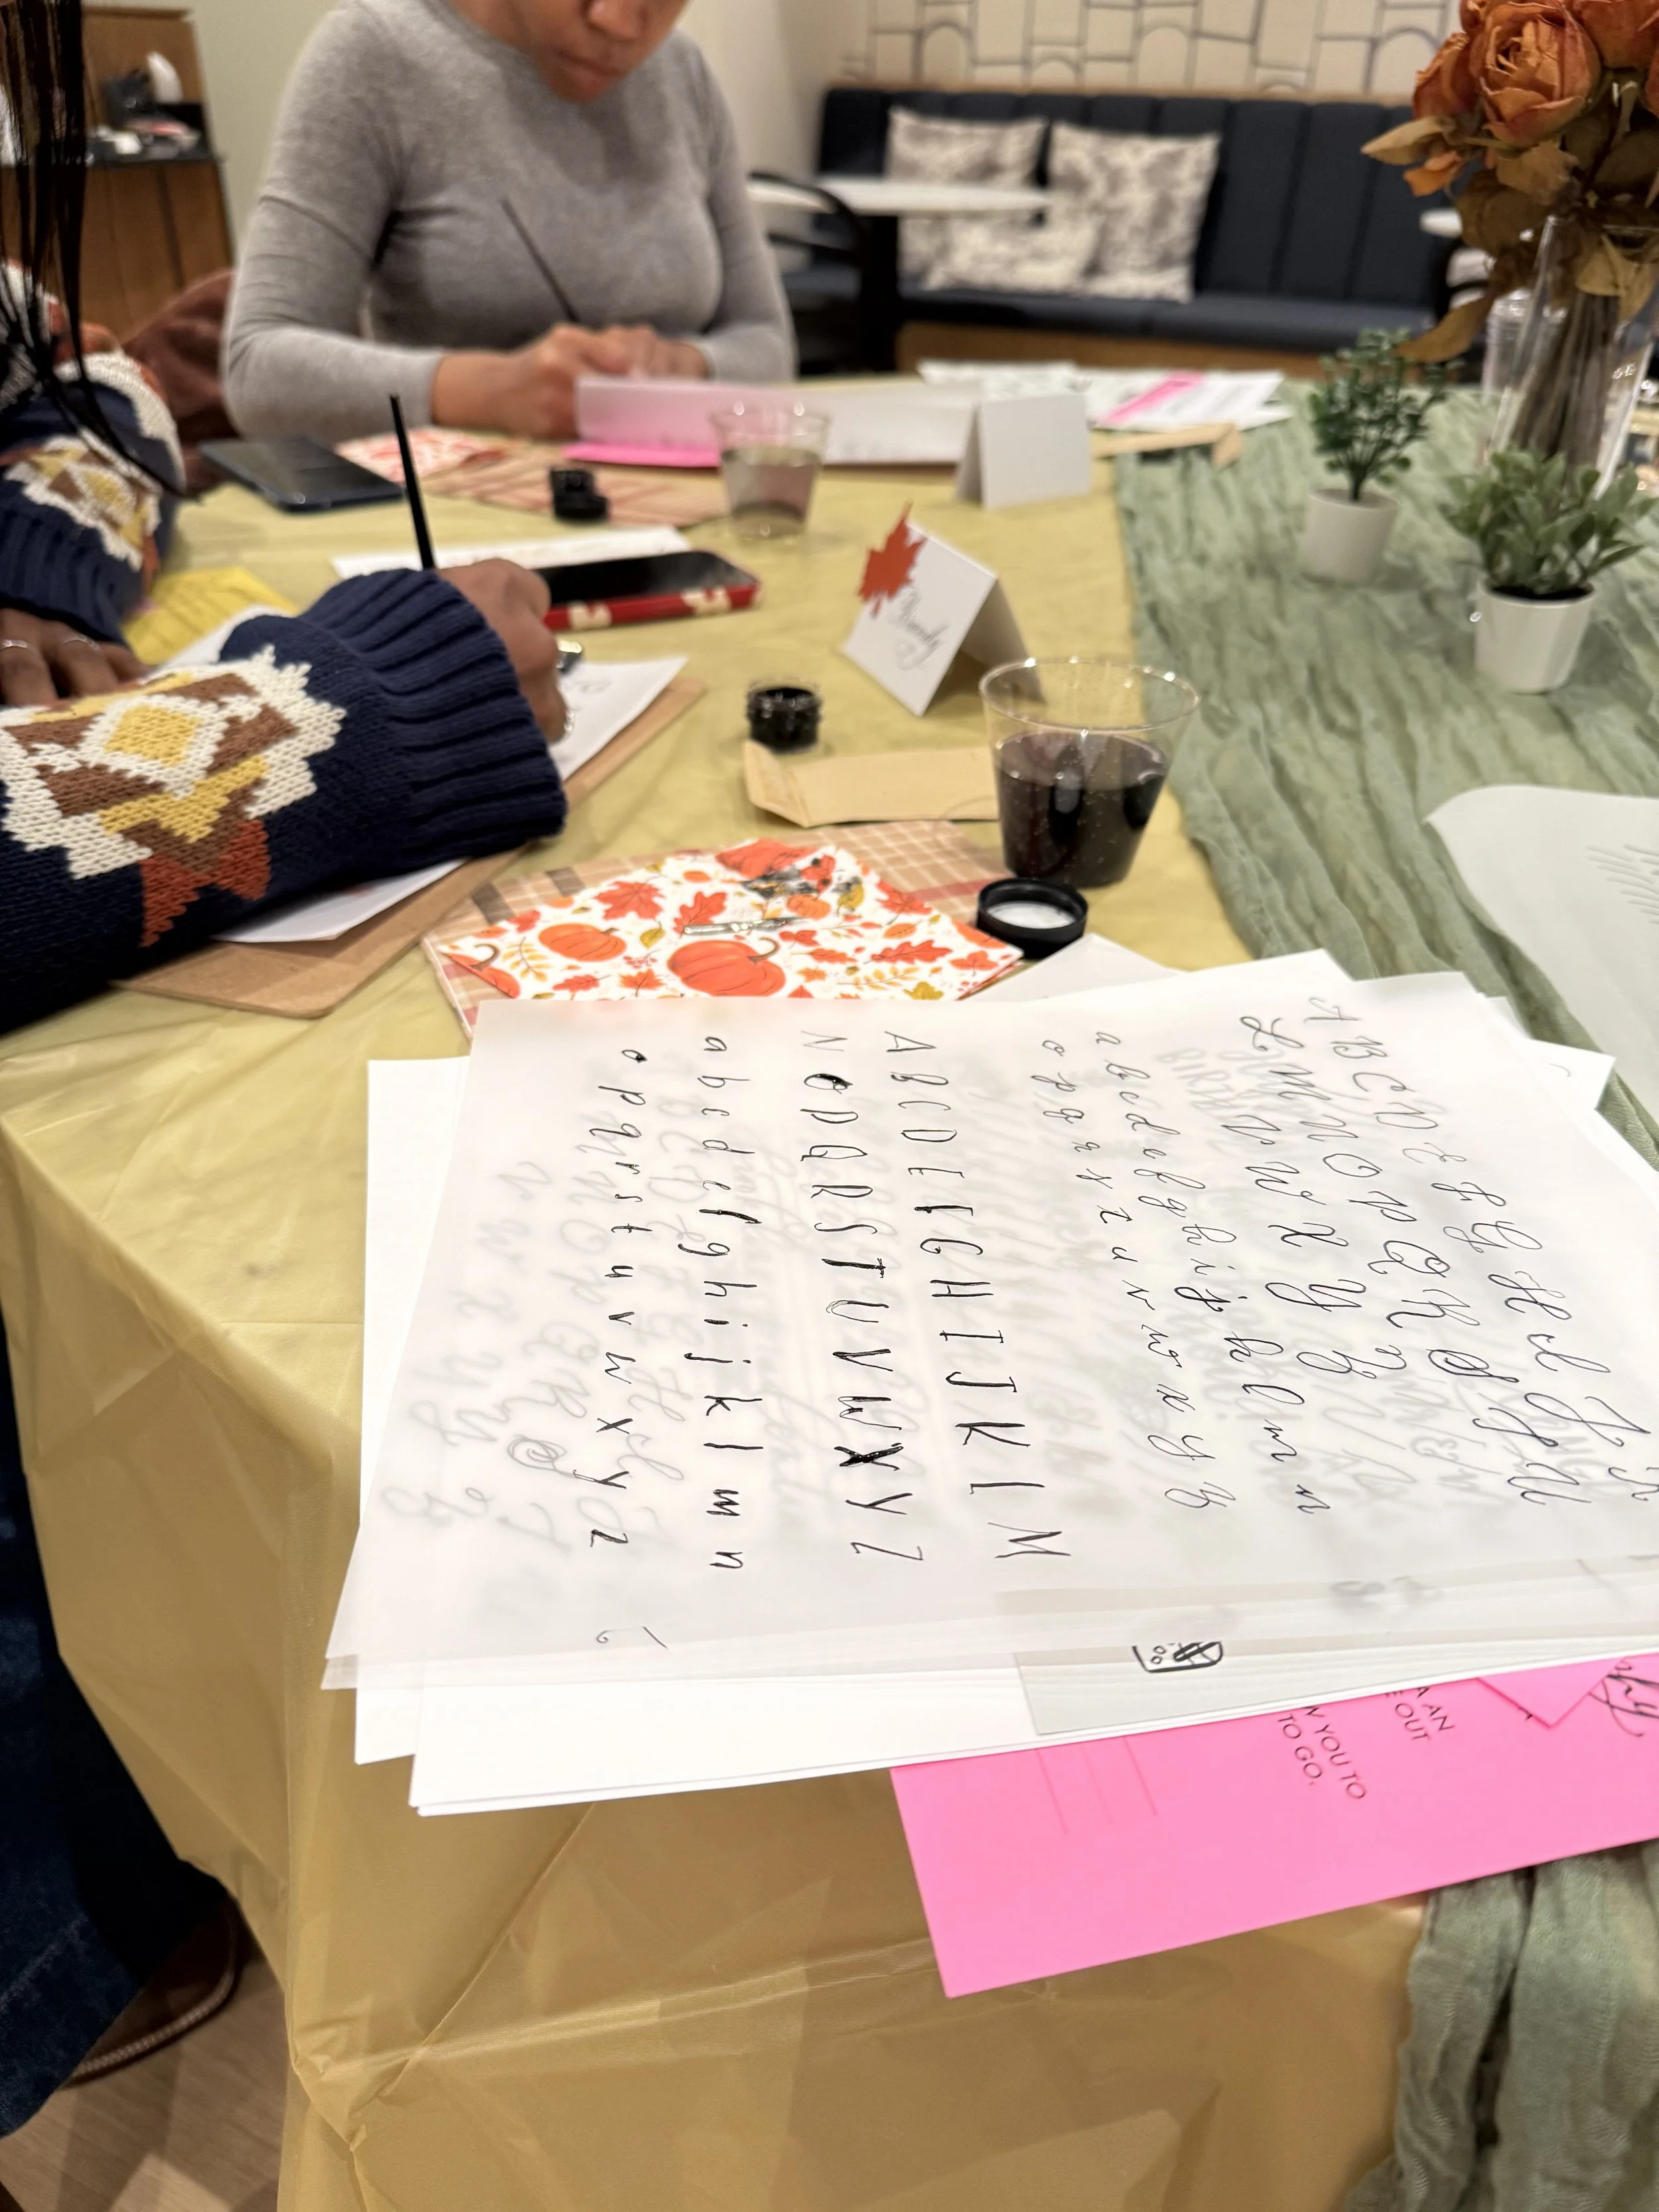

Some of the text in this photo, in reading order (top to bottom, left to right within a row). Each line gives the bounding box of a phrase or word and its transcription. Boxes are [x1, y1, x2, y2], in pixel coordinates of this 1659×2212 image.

[703, 1037, 727, 1052] a
[801, 1031, 848, 1052] N
[697, 1075, 751, 1088] b
[598, 1086, 646, 1106] p
[701, 1108, 730, 1116] c
[800, 1108, 859, 1124] P
[589, 1123, 642, 1139] q
[700, 1140, 755, 1154] d
[800, 1145, 868, 1161] Q
[615, 1162, 640, 1175] r
[703, 1180, 731, 1191] e
[810, 1185, 873, 1199] R
[611, 1223, 653, 1233] t
[814, 1222, 878, 1234] S
[678, 1242, 731, 1256] g
[605, 1266, 634, 1278] u
[821, 1258, 886, 1278] T
[703, 1281, 757, 1297] h
[885, 1031, 1071, 1558] A B C D E F G H I J K L M
[609, 1311, 635, 1325] v
[826, 1300, 889, 1323] U
[684, 1353, 751, 1363] j
[832, 1349, 893, 1372] V
[605, 1352, 636, 1384] w
[704, 1395, 762, 1416] k
[837, 1396, 902, 1430] W
[596, 1418, 633, 1434] x
[833, 1443, 904, 1471] X
[573, 1469, 630, 1489] y
[706, 1489, 741, 1516] m
[845, 1493, 913, 1514] Y
[590, 1529, 628, 1547] z
[709, 1551, 743, 1569] n
[850, 1542, 924, 1561] Z
[1395, 1702, 1432, 1741] OUT
[1421, 1703, 1456, 1732] AN
[1277, 1713, 1323, 1785] TO GO.
[1314, 1724, 1352, 1767] YOU
[1339, 1771, 1366, 1799] TO
